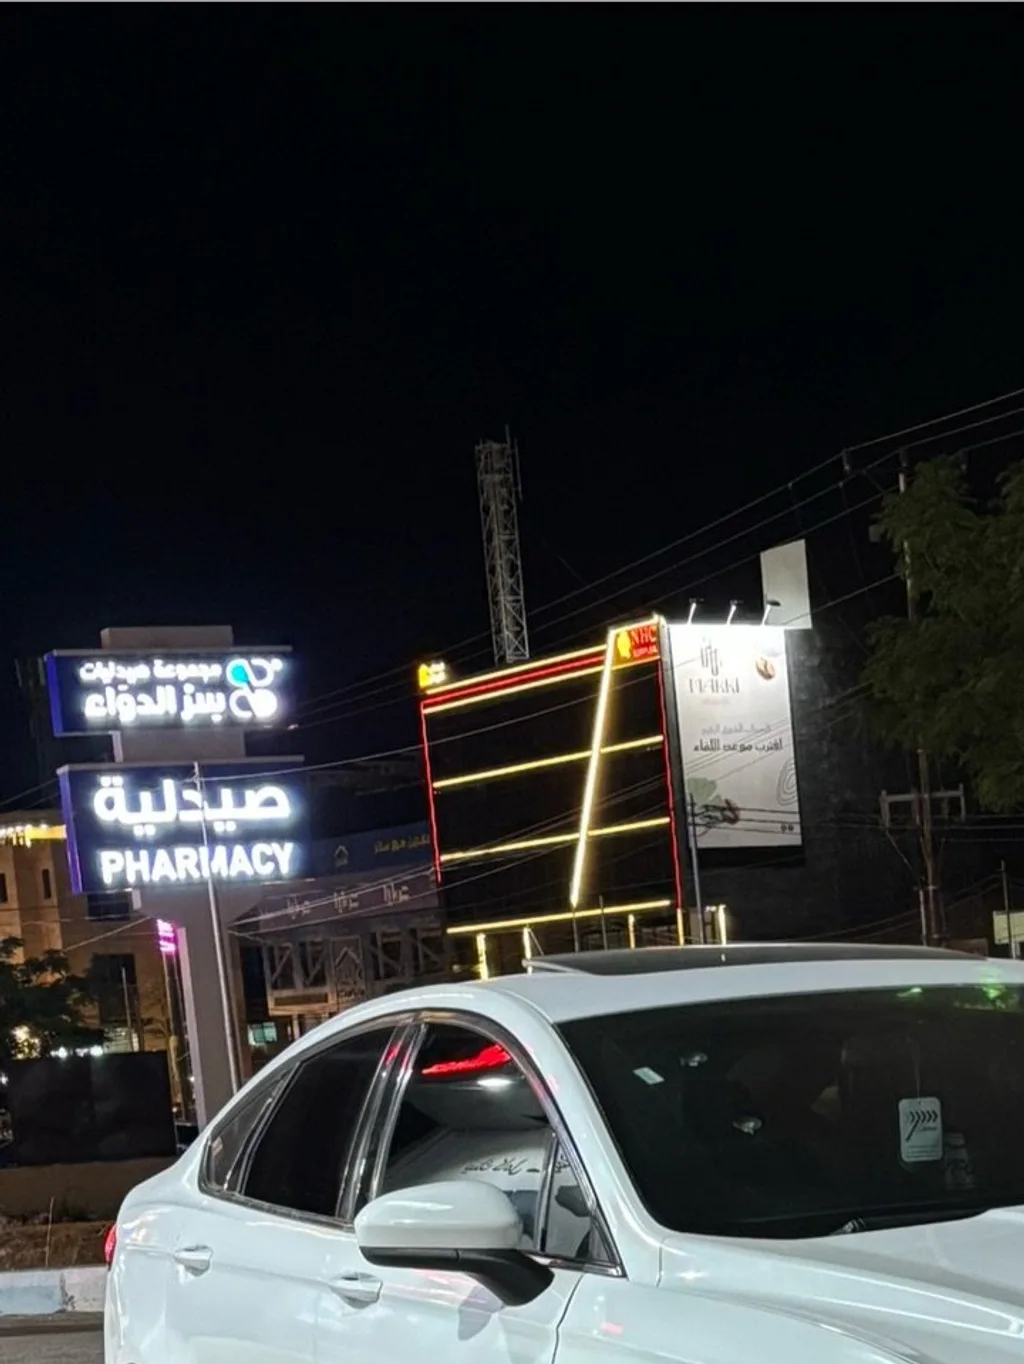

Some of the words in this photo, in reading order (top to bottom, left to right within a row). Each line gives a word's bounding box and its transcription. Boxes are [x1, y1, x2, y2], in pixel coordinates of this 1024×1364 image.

[80, 660, 151, 685] صيدليات
[154, 659, 222, 683] مجموعة
[93, 776, 291, 837] صيدلية
[99, 842, 294, 885] PHARMACY
